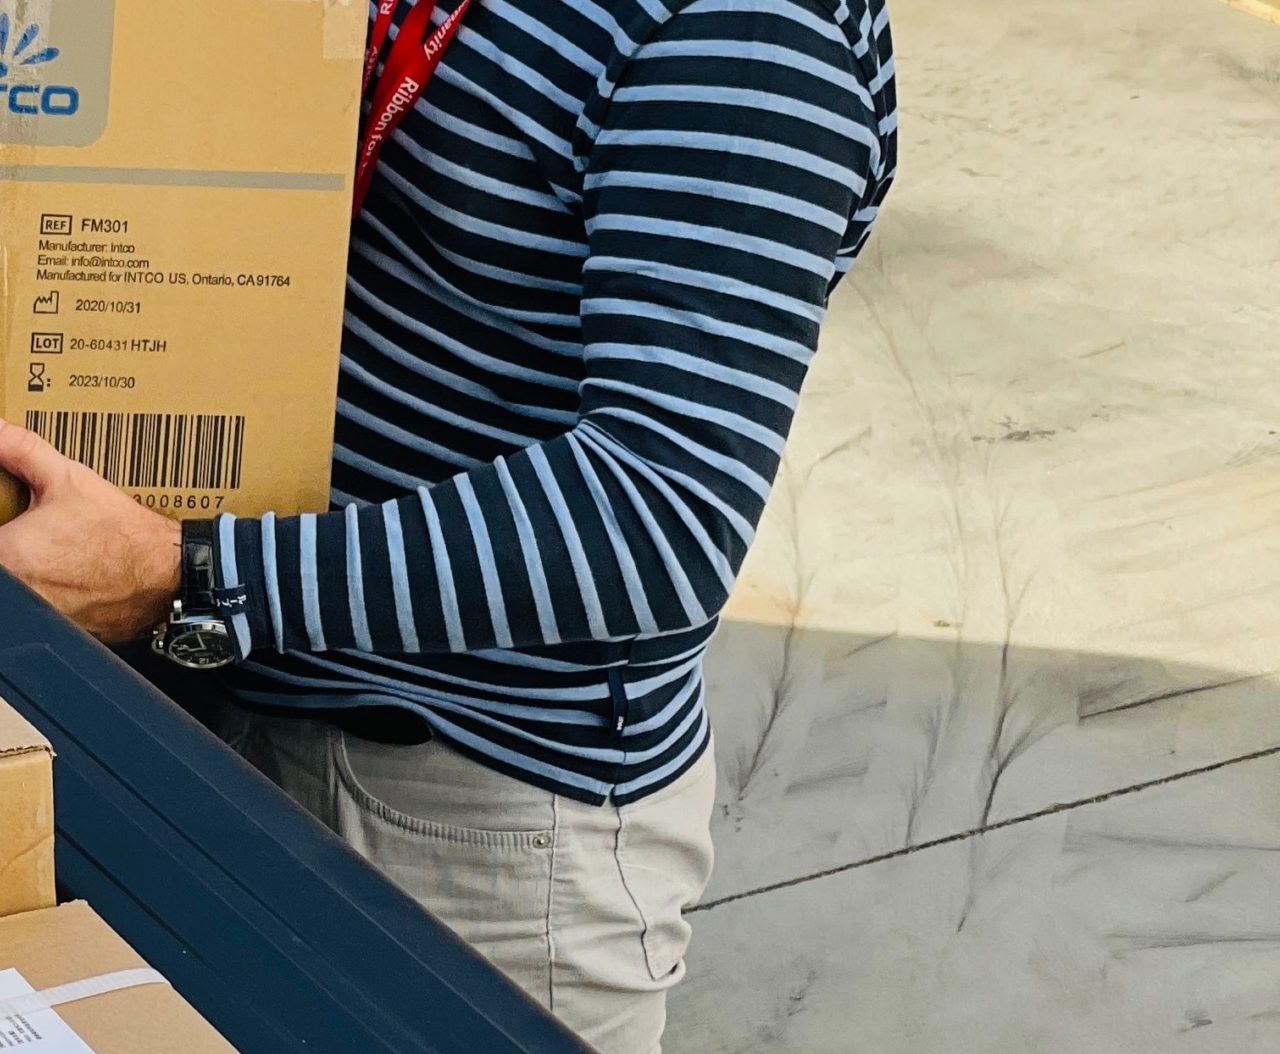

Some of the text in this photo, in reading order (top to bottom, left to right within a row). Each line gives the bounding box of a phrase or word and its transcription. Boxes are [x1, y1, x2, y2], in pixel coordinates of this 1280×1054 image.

[375, 76, 420, 131] Ribbon
[45, 219, 128, 233] REF FM301
[110, 242, 136, 254] Intco
[71, 255, 150, 269] info@intco.com
[36, 269, 106, 282] Manufactured
[108, 271, 122, 283] for
[124, 272, 164, 284] INTCO
[75, 299, 141, 314] 2020/10/31
[35, 337, 60, 349] LOT
[69, 338, 128, 351] 20-60431
[68, 374, 136, 389] 2023/10/30
